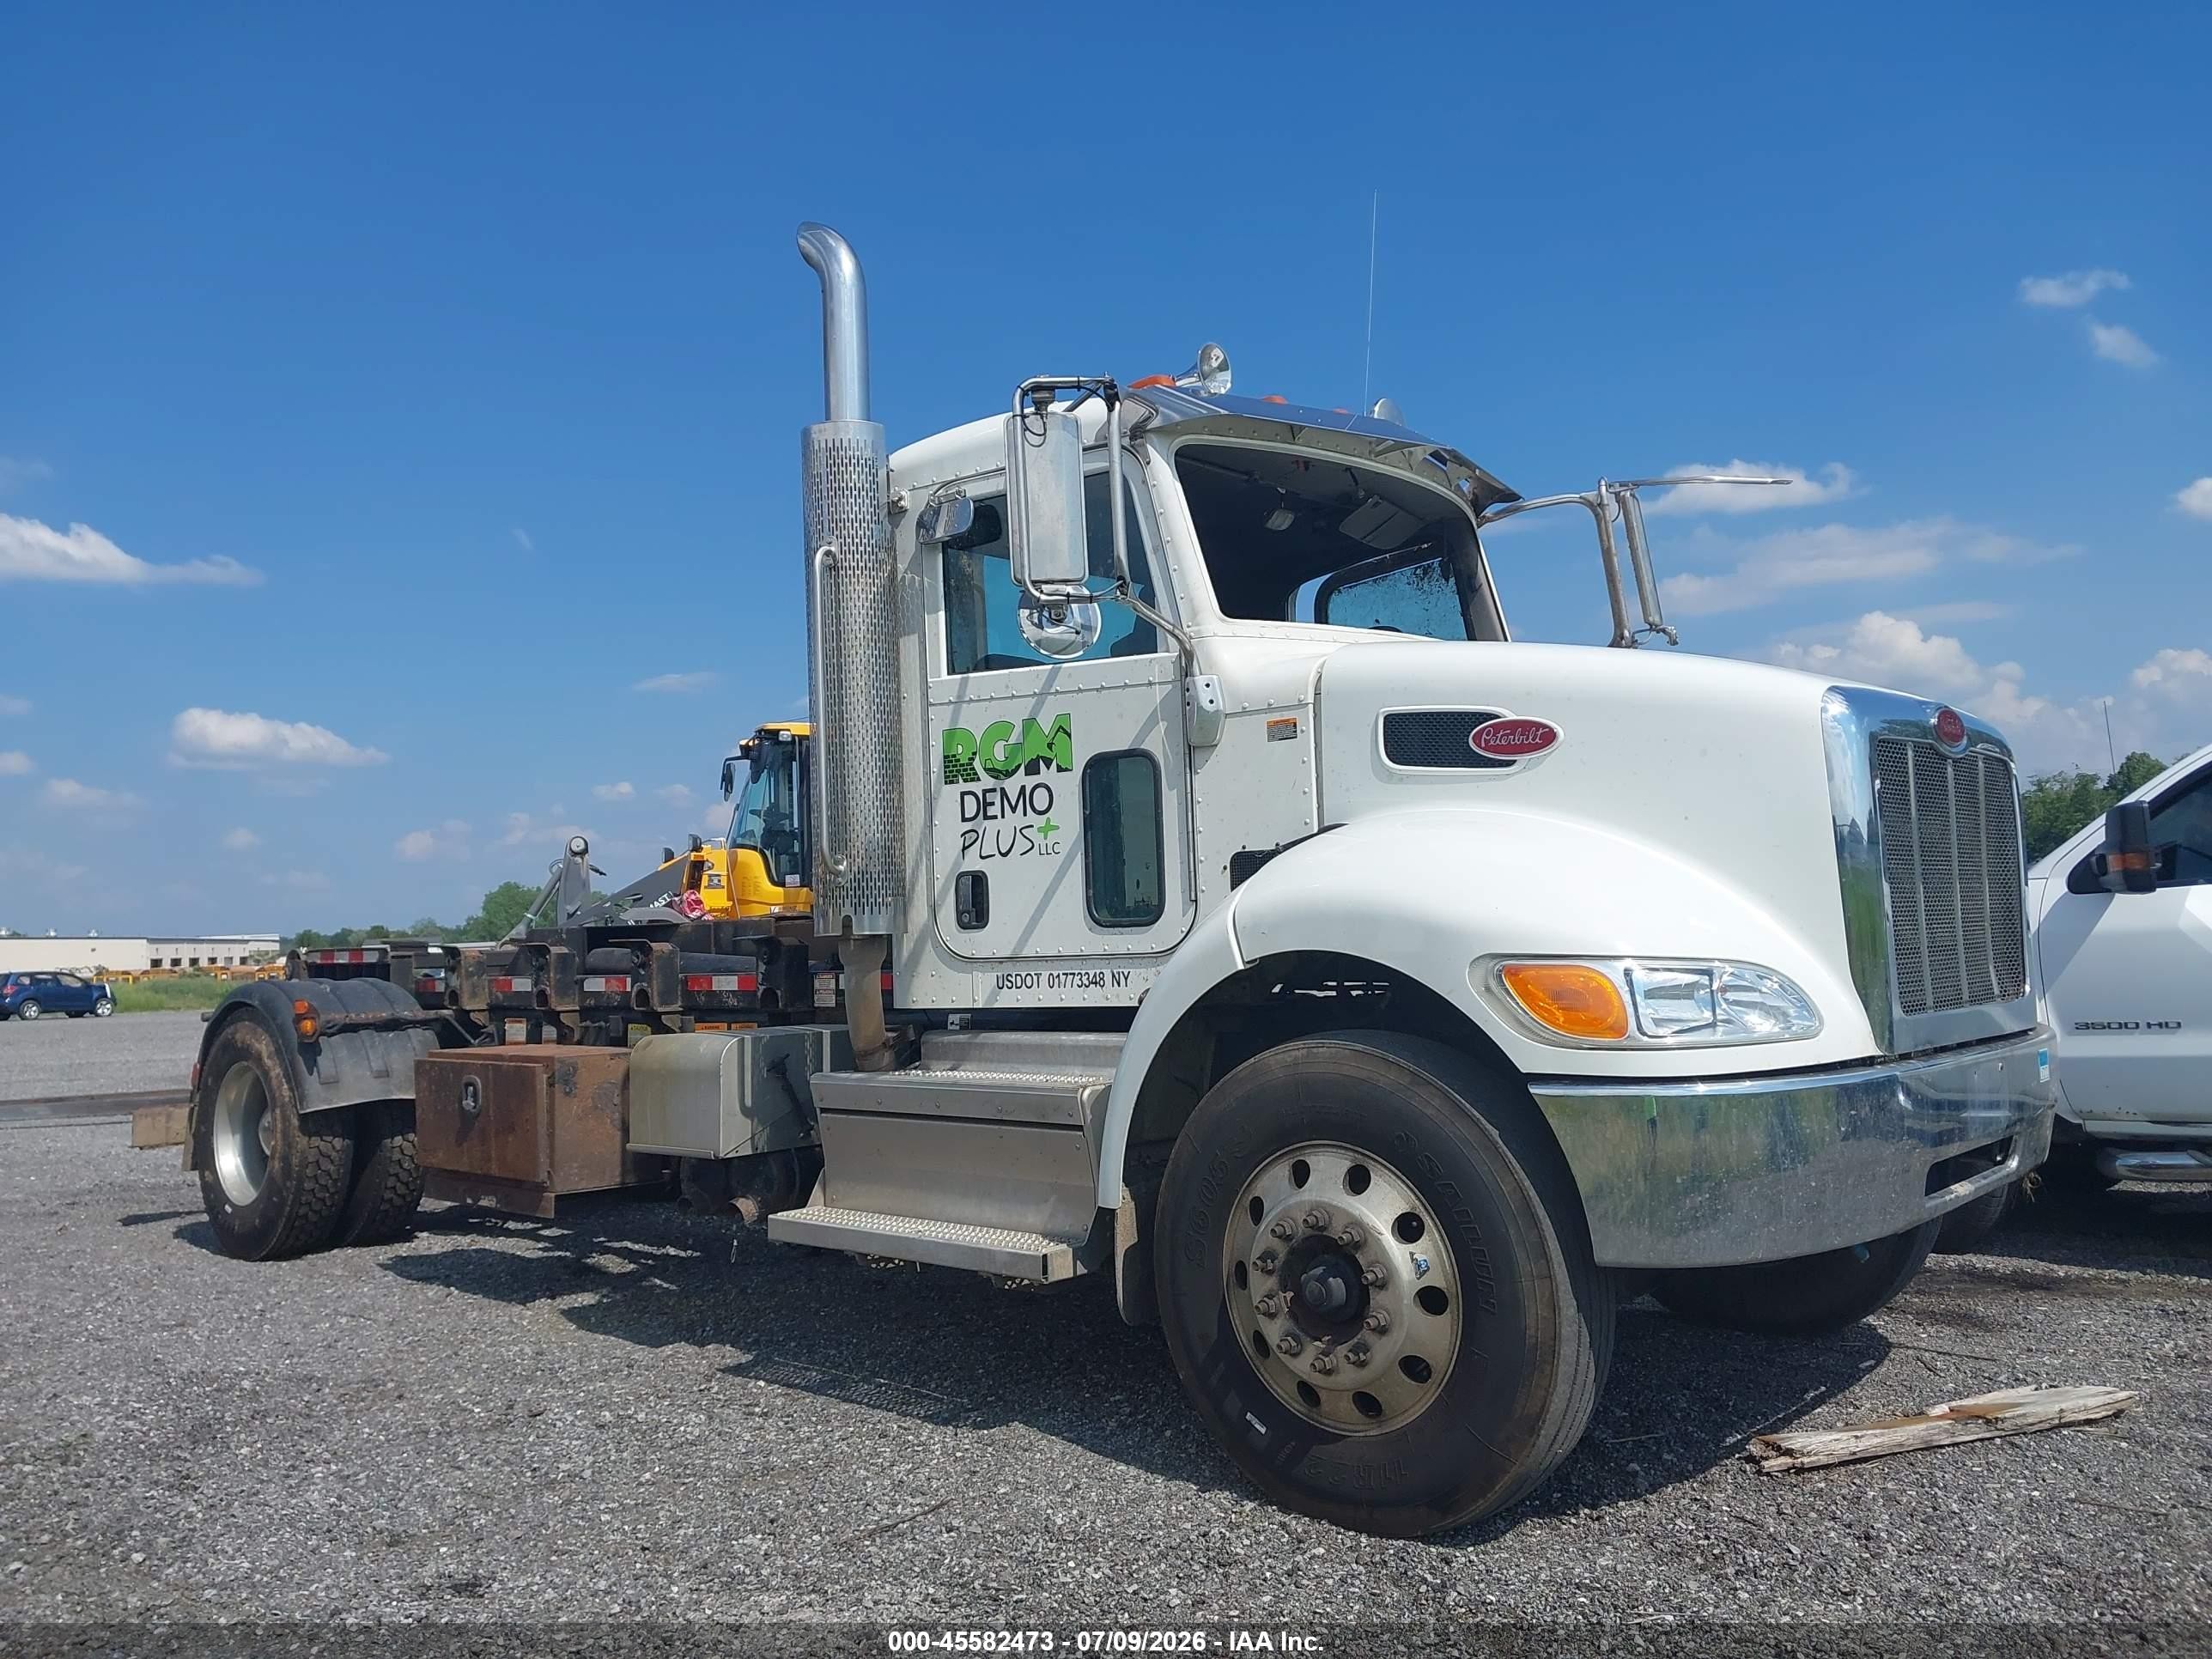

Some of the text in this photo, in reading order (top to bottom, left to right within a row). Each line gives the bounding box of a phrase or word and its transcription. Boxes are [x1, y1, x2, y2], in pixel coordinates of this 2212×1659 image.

[1481, 727, 1549, 748] Peterbilt
[942, 713, 1073, 786] RGM
[959, 782, 1054, 823] DEMO
[1038, 842, 1061, 855] LLC
[996, 970, 1131, 990] USDOT 01773348 NY
[2075, 1021, 2181, 1030] 3500 HD
